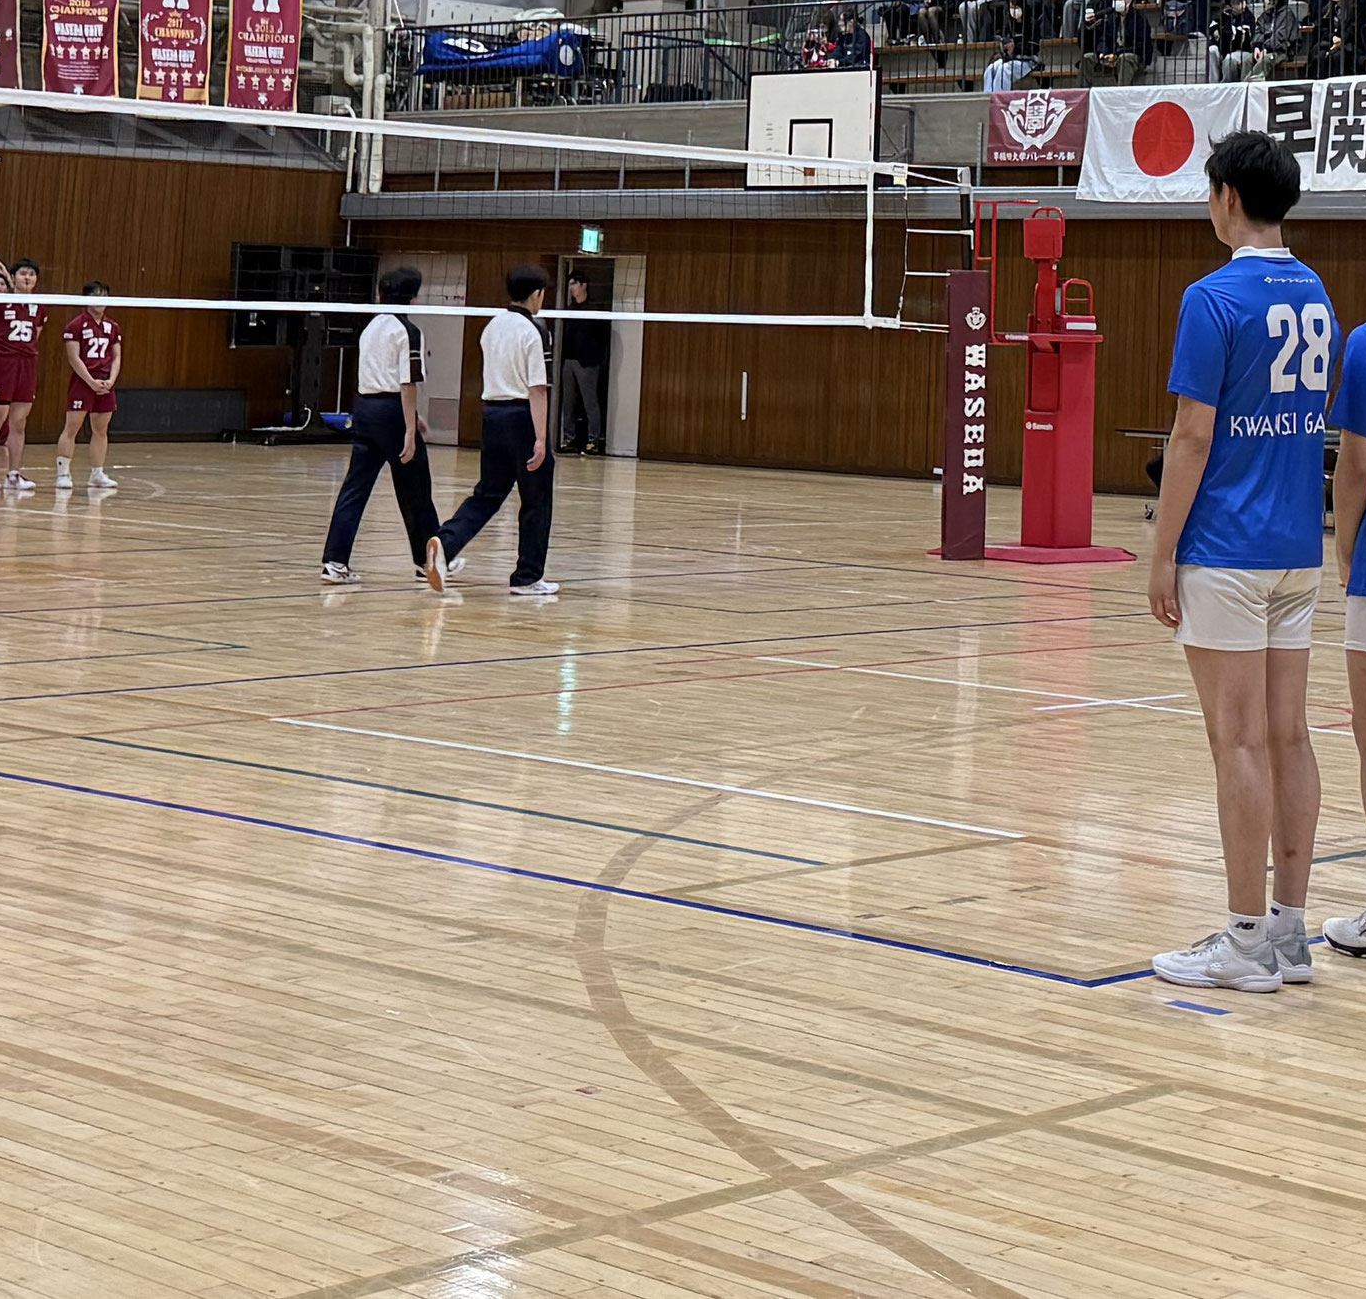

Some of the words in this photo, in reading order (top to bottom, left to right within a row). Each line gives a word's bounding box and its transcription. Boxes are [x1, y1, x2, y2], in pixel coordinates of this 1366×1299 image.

[237, 32, 295, 44] CHAMPIONS
[8, 319, 33, 342] 25
[86, 337, 109, 359] 27
[1266, 303, 1332, 394] 28
[962, 342, 987, 495] WASEDA
